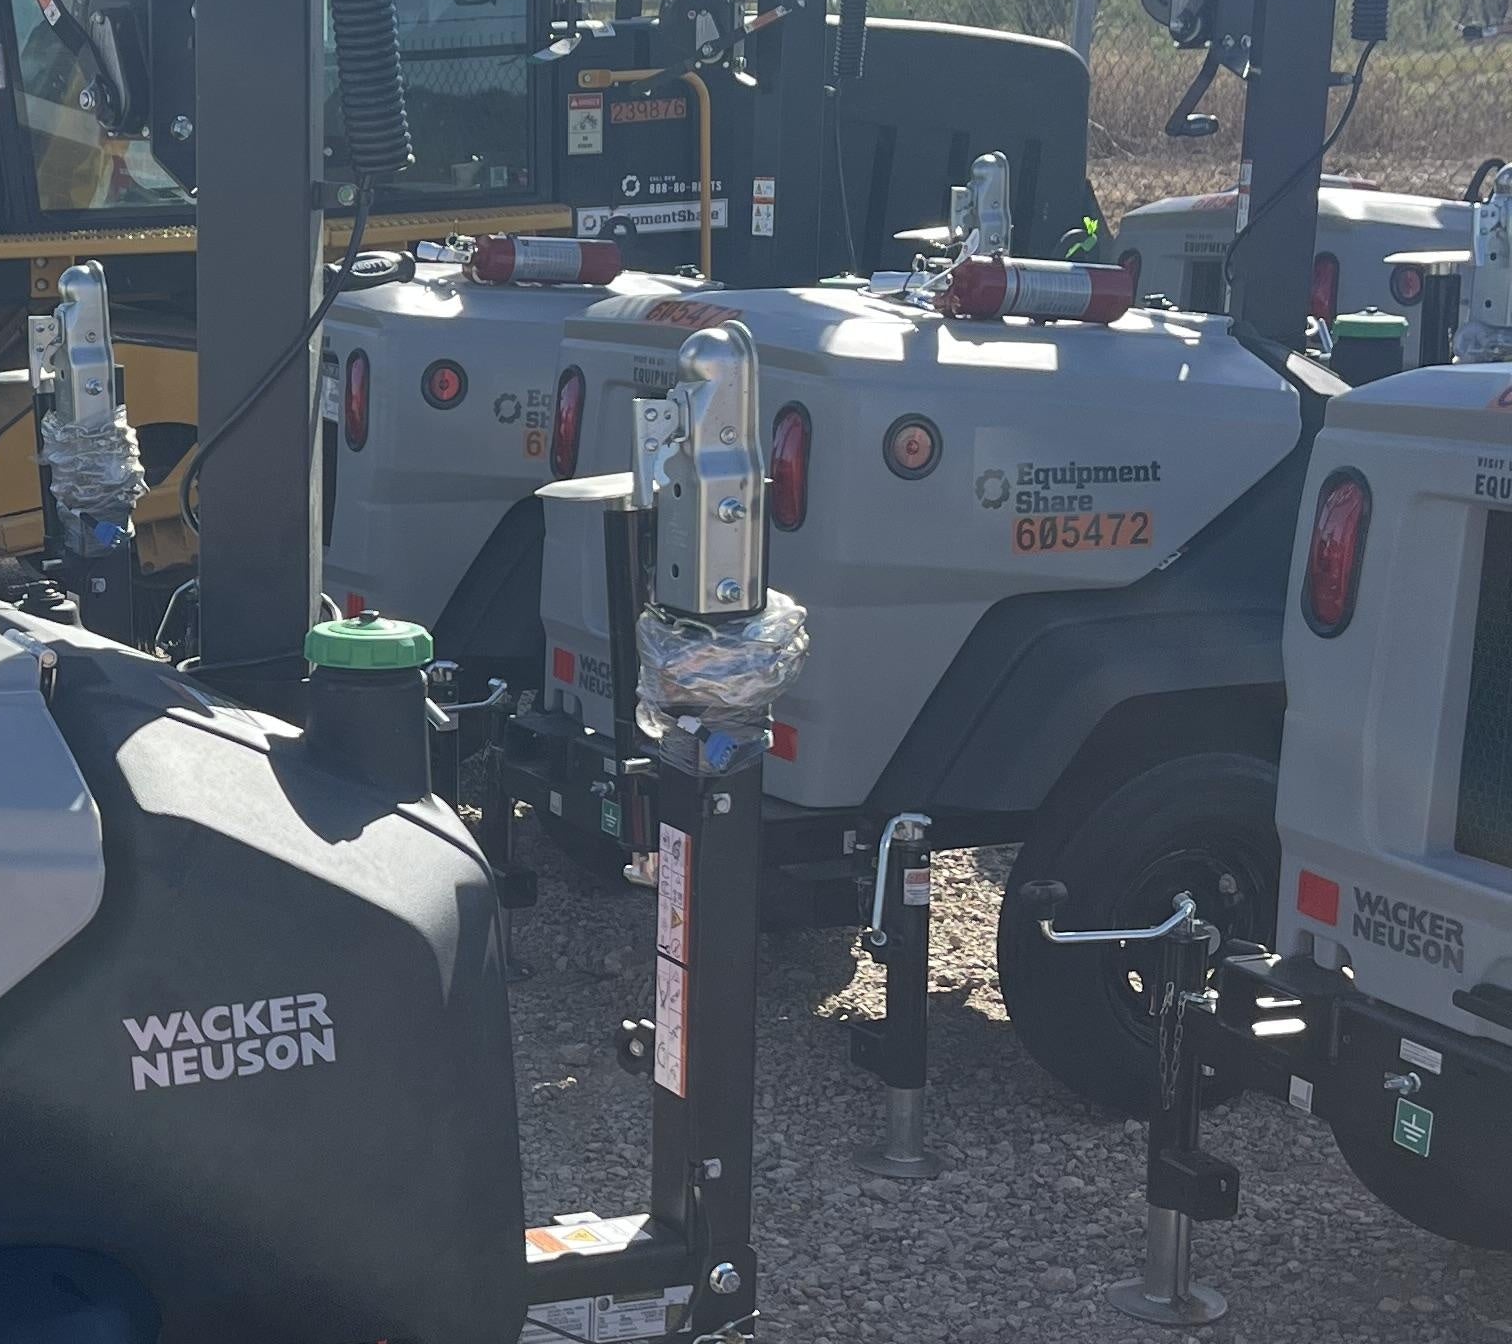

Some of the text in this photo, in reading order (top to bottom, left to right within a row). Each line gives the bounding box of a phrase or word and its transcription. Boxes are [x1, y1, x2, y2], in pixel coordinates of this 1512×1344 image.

[612, 100, 685, 122] 239876
[649, 180, 722, 194] 888-80-RTS
[1016, 461, 1161, 490] Equipment
[1015, 490, 1094, 514] Share
[1015, 511, 1149, 551] 605472
[1353, 886, 1464, 947] WACKER
[1352, 912, 1464, 974] NEUSON
[122, 992, 335, 1052] WACKER
[131, 1028, 337, 1091] NEUSON
